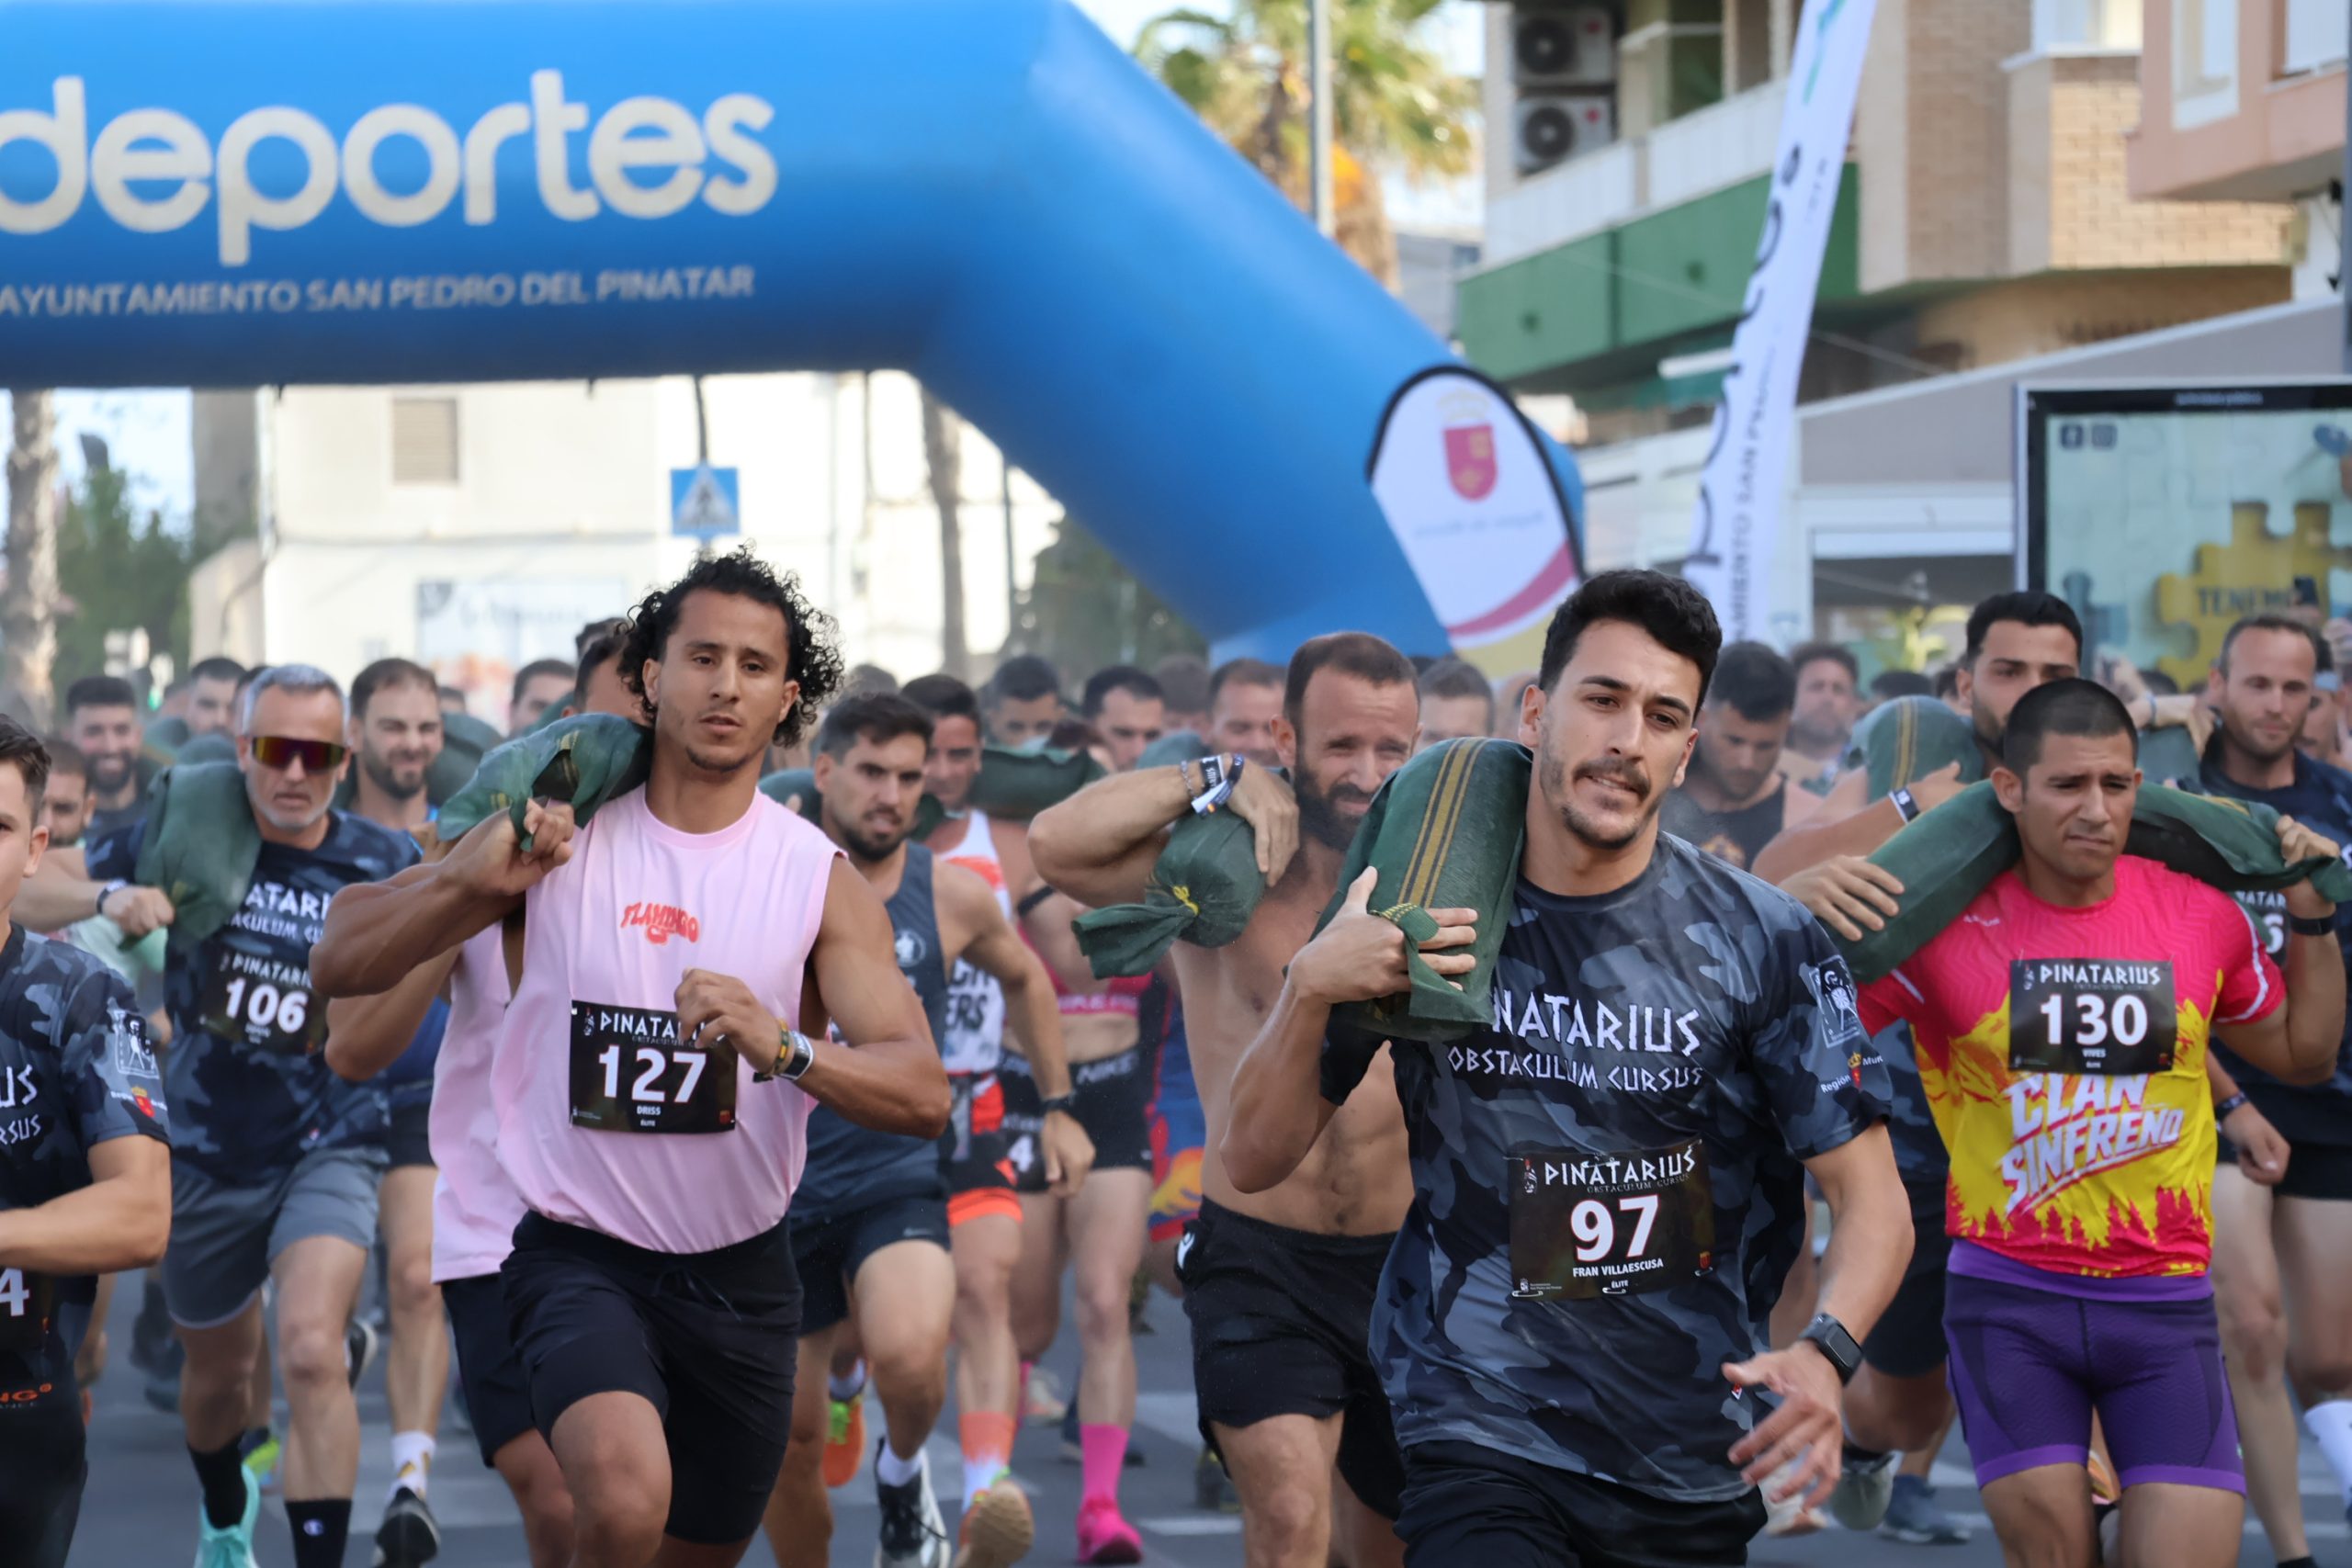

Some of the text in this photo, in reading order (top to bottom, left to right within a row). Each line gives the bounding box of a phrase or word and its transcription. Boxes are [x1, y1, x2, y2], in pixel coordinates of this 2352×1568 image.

[0, 69, 778, 266] deportes
[0, 264, 755, 316] AYUNTAMIENTO SAN PEDRO DEL PINATAR
[620, 901, 700, 944] FLAMINGO
[2040, 964, 2161, 985] PINATARIUS
[225, 977, 309, 1034] 106
[2040, 993, 2148, 1045] 130
[598, 1043, 707, 1103] 127
[1447, 1044, 1703, 1093] OBSTACULUM CURSUS
[636, 1105, 662, 1116] DRISS
[1544, 1145, 1696, 1186] PINATARIUS
[1997, 1108, 2185, 1215] SINFRENO
[1569, 1194, 1659, 1262] 97
[1572, 1258, 1664, 1279] FRAN VILLAESCUSA
